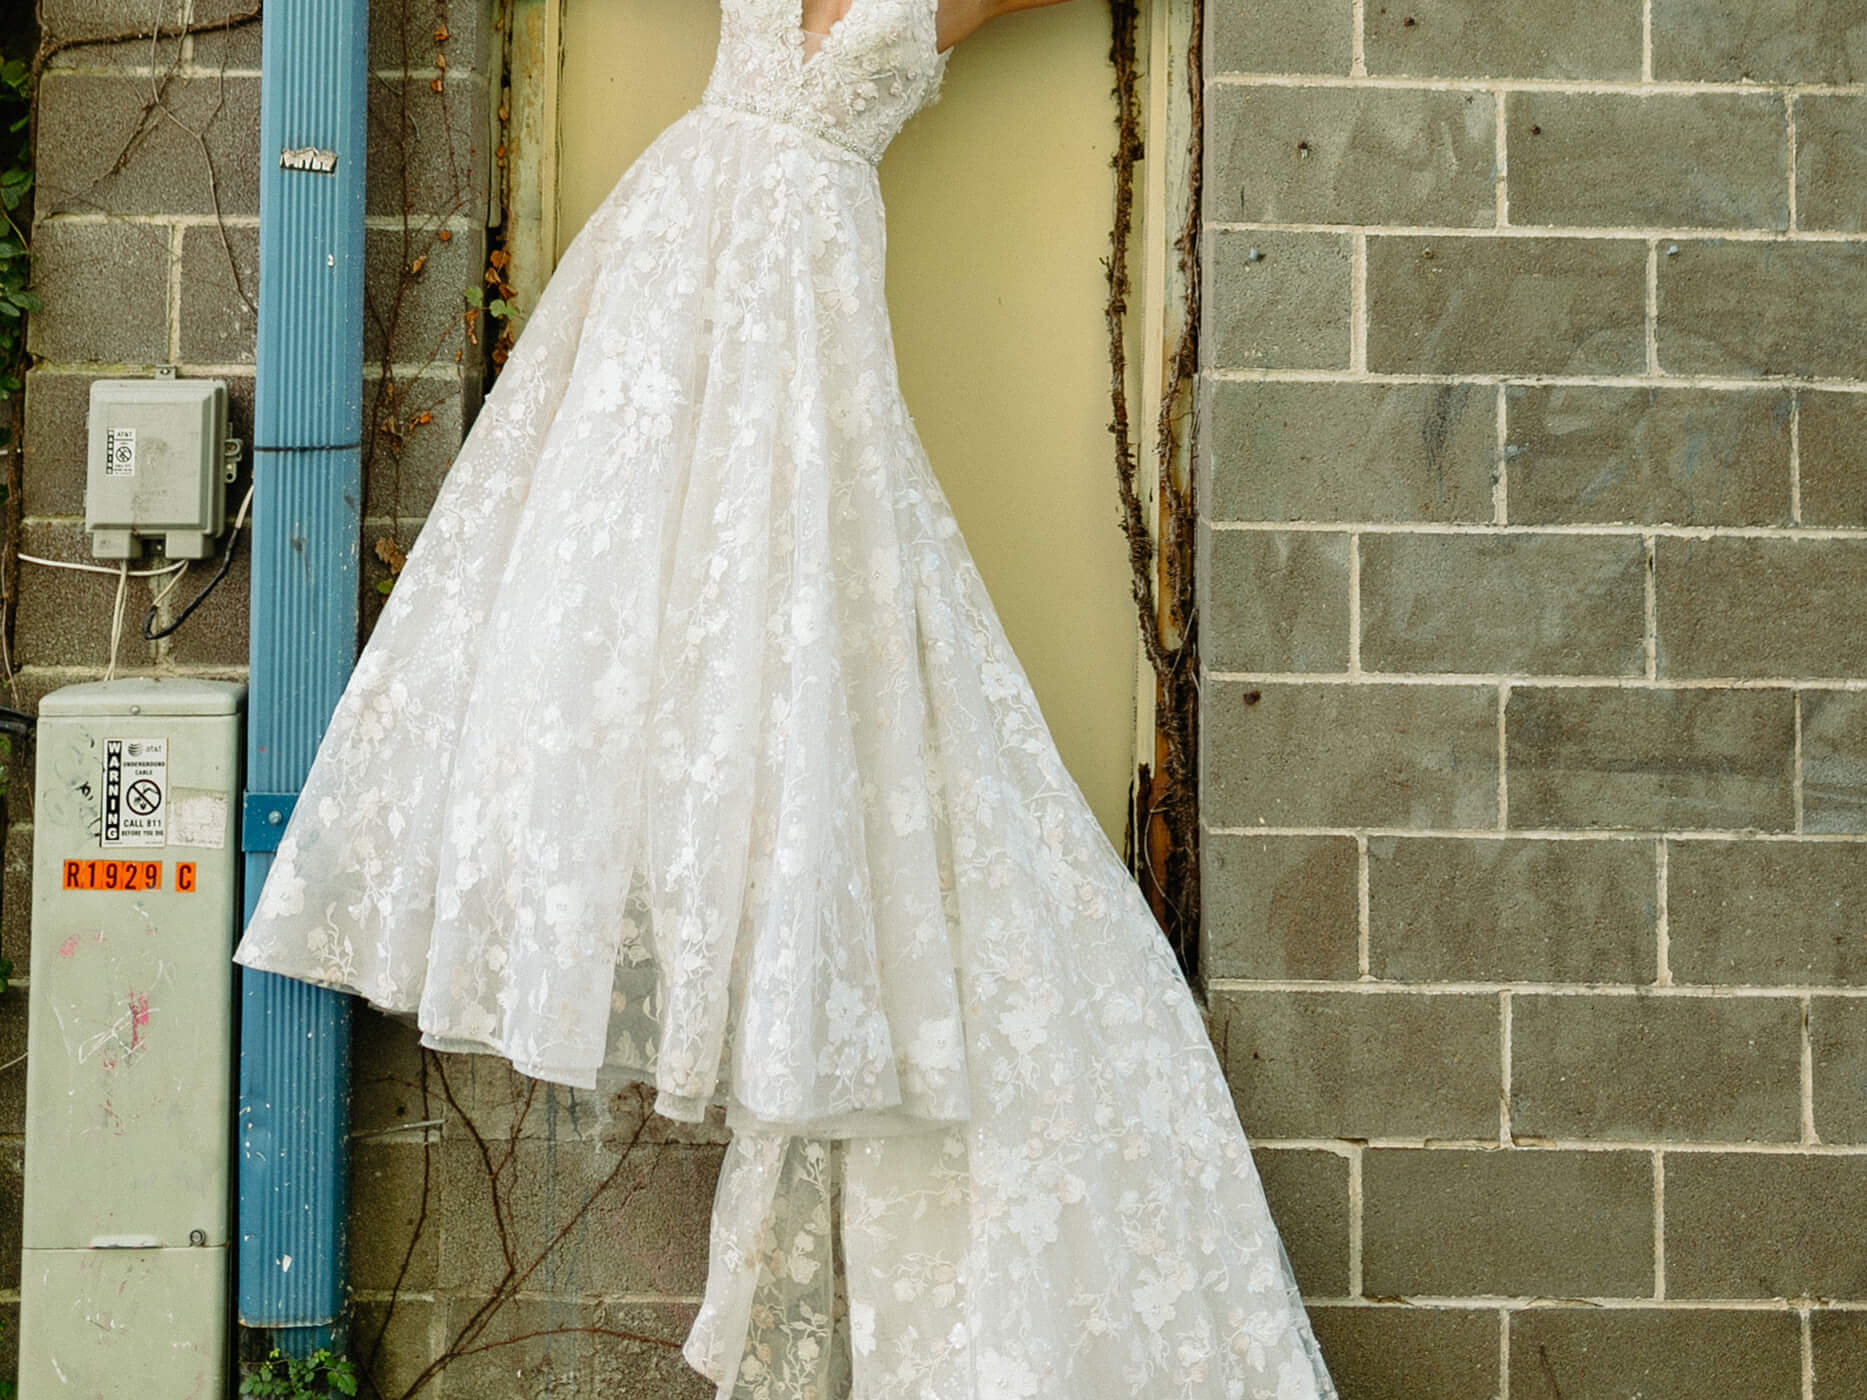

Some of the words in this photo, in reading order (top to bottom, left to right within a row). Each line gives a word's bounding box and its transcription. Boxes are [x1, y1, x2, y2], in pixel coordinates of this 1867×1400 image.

[107, 742, 121, 839] WARNING
[123, 819, 143, 828] CALL
[146, 819, 162, 828] 811
[66, 862, 157, 890] R1929
[179, 865, 192, 890] C
